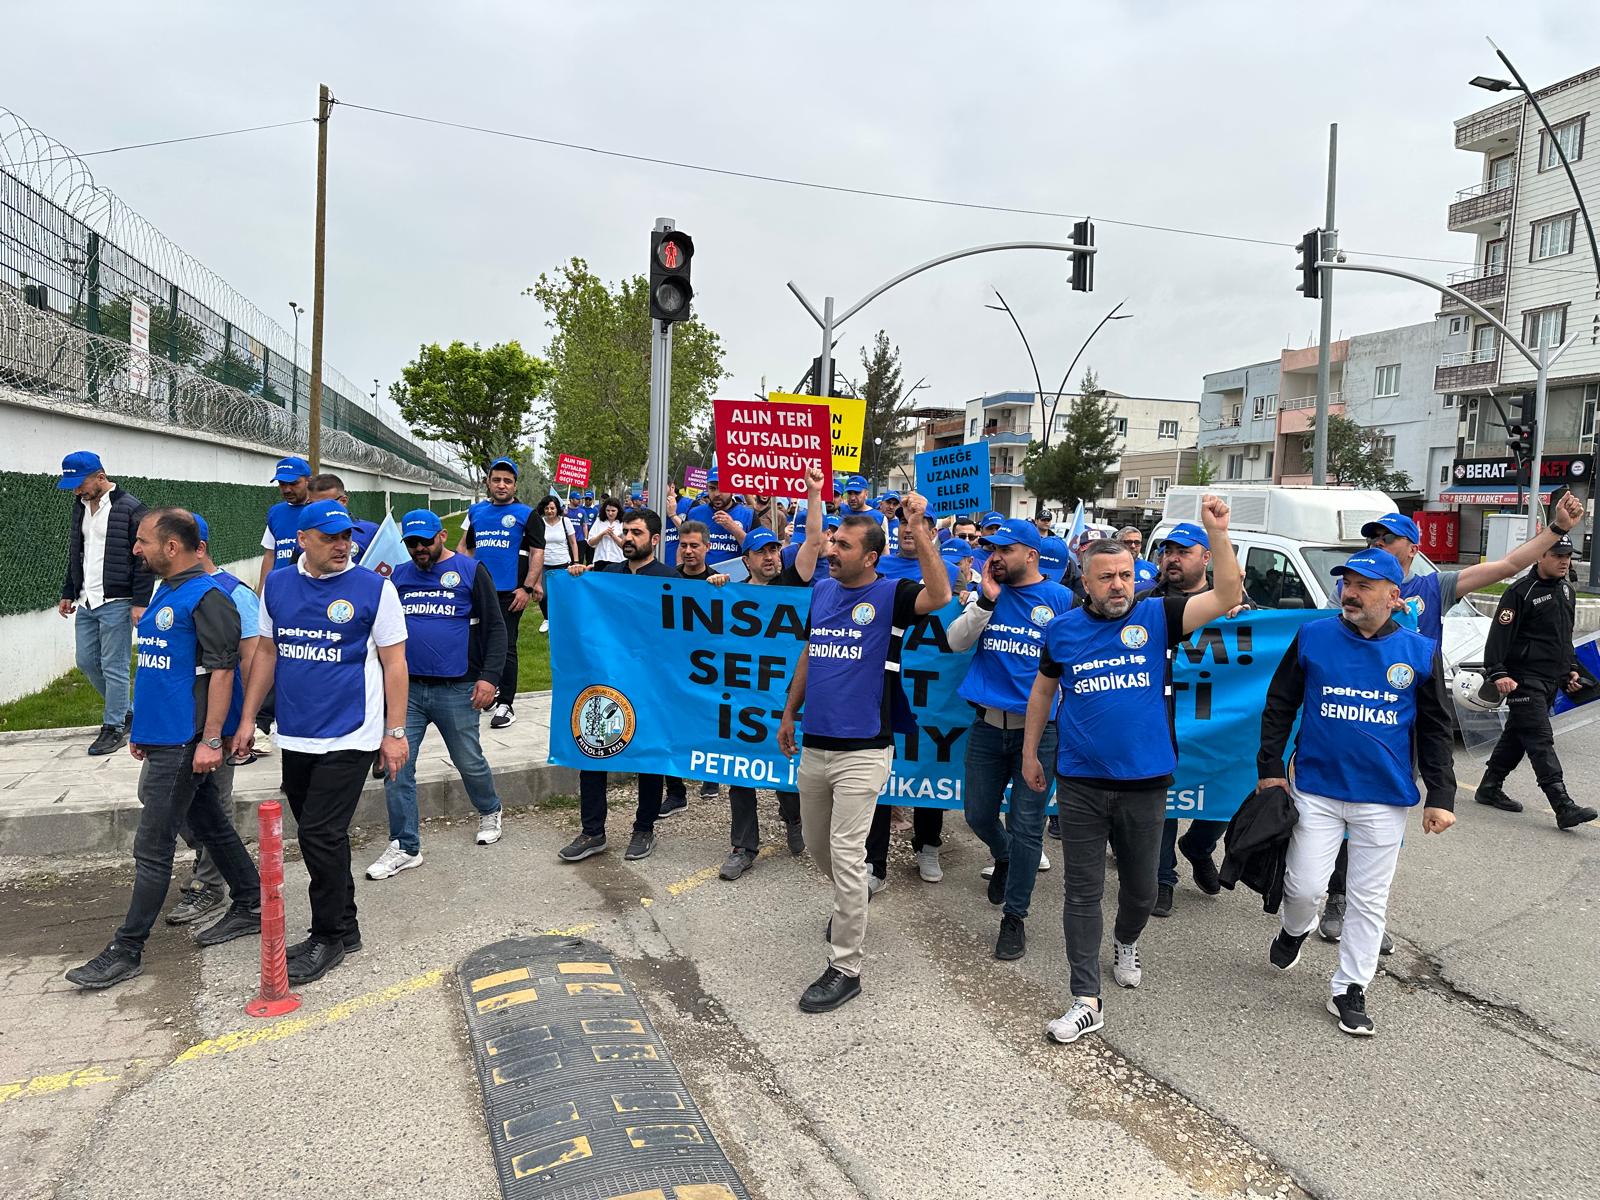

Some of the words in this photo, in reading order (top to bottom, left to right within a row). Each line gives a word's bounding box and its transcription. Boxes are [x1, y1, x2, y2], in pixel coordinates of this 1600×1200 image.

[731, 409, 771, 425] ALIN
[777, 409, 813, 428] TERİ
[726, 430, 821, 450] KUTSALDIR
[727, 449, 822, 471] SÖMÜRÜYE
[932, 448, 971, 467] EMEĞE
[926, 464, 979, 483] UZANAN
[1466, 463, 1508, 478] BERAT
[730, 471, 779, 493] GEÇİT
[784, 477, 808, 492] YO
[937, 483, 970, 496] ELLER
[1454, 495, 1475, 503] BERAT
[1475, 495, 1504, 504] MARKET
[403, 590, 455, 600] petrol-iş
[277, 627, 342, 642] petrol-iş
[811, 627, 863, 640] petrol-iş
[984, 623, 1042, 640] petrol-iş
[278, 643, 342, 662] SENDİKASI
[983, 637, 1041, 658] SENDİKASI
[1072, 654, 1147, 675] petrol-iş
[1074, 672, 1151, 694] SENDİKASI
[1322, 685, 1399, 703] petrol-iş
[1320, 702, 1398, 725] SENDİKASI
[690, 750, 781, 783] PETROL
